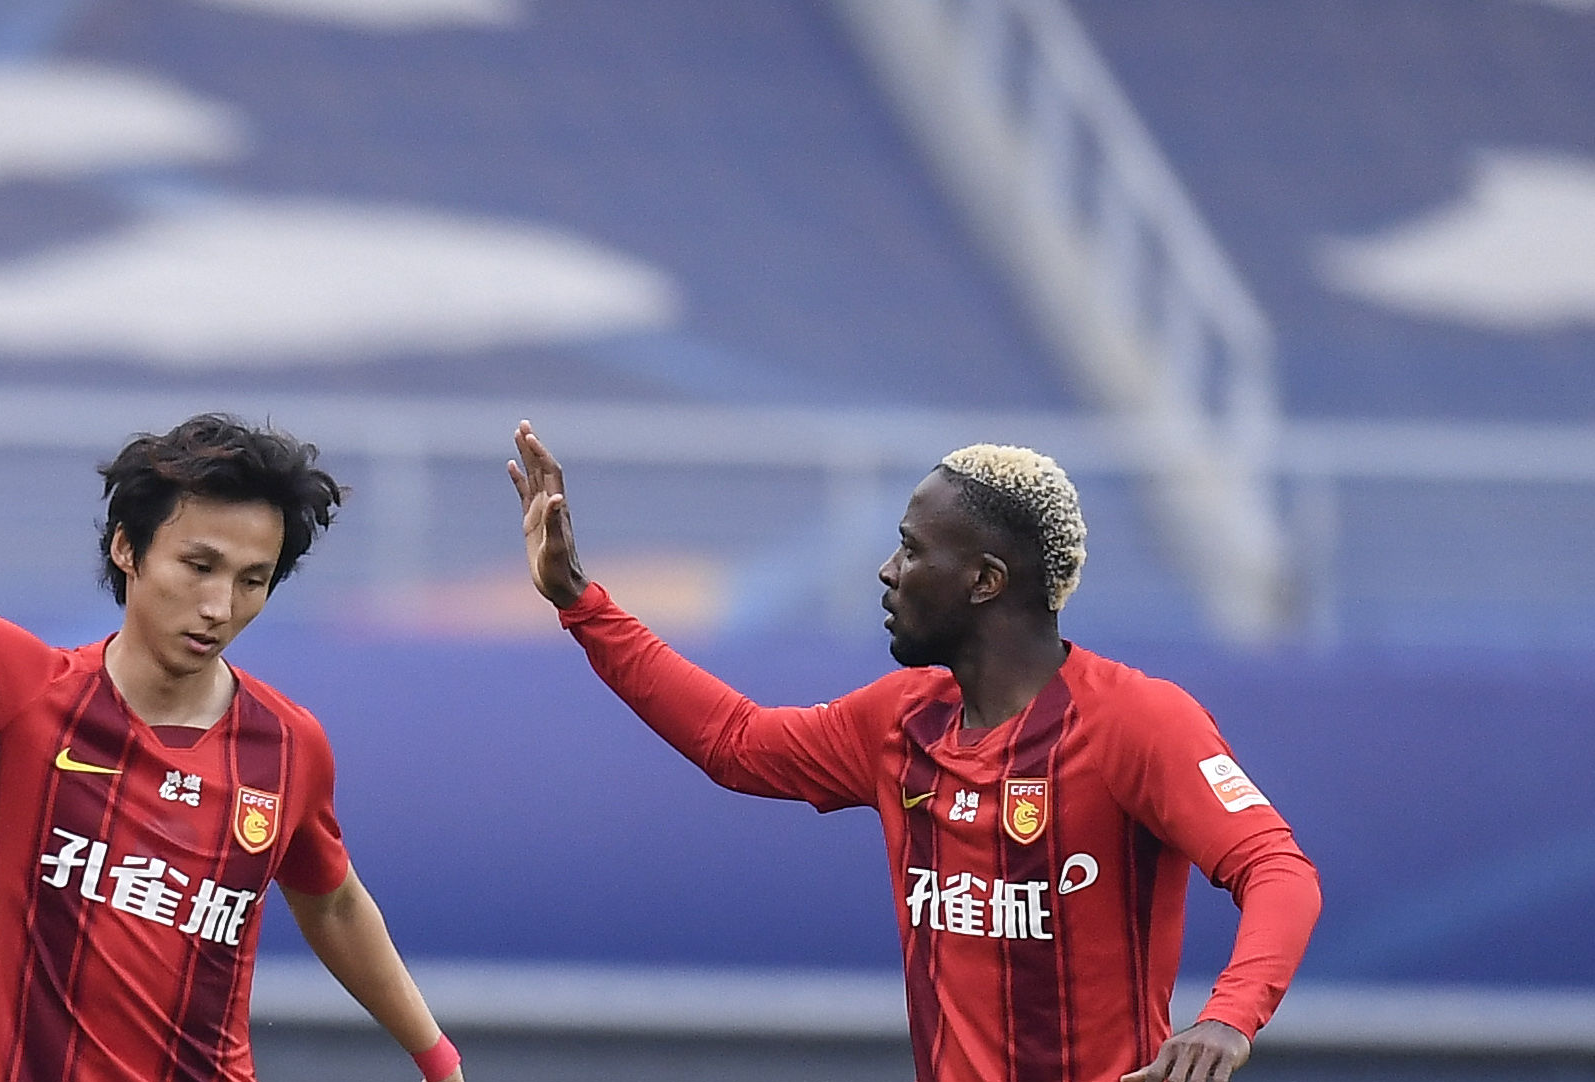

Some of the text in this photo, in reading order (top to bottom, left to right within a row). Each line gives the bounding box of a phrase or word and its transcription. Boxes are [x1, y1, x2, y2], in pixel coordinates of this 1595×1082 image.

[242, 793, 274, 810] CFFC
[1010, 785, 1044, 796] CFFC
[40, 827, 257, 946] 孔雀城
[905, 866, 1054, 940] 孔雀城
